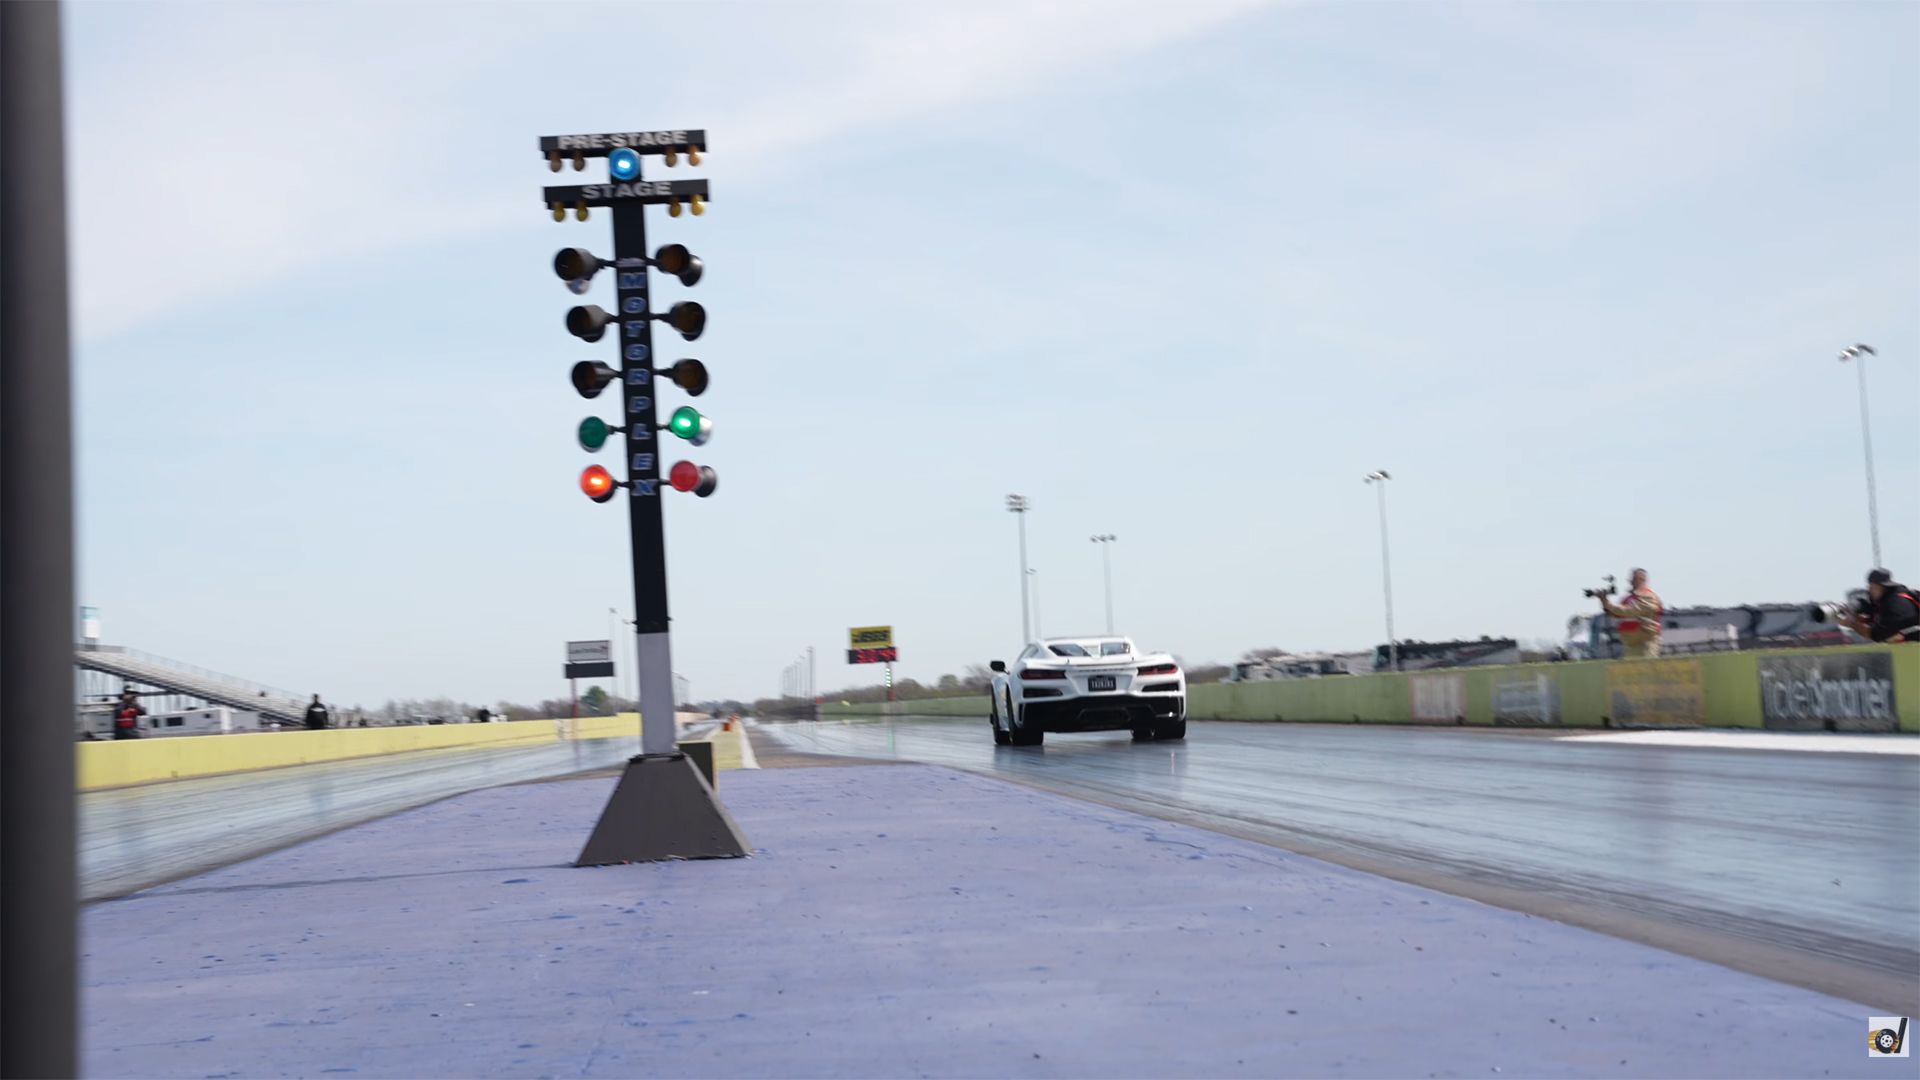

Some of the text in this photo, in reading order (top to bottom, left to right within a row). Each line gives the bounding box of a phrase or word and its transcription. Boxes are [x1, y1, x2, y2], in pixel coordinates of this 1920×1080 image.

[557, 130, 688, 150] PRE-STAGE
[581, 181, 673, 199] STAGE
[618, 272, 657, 496] MOTORPLEX
